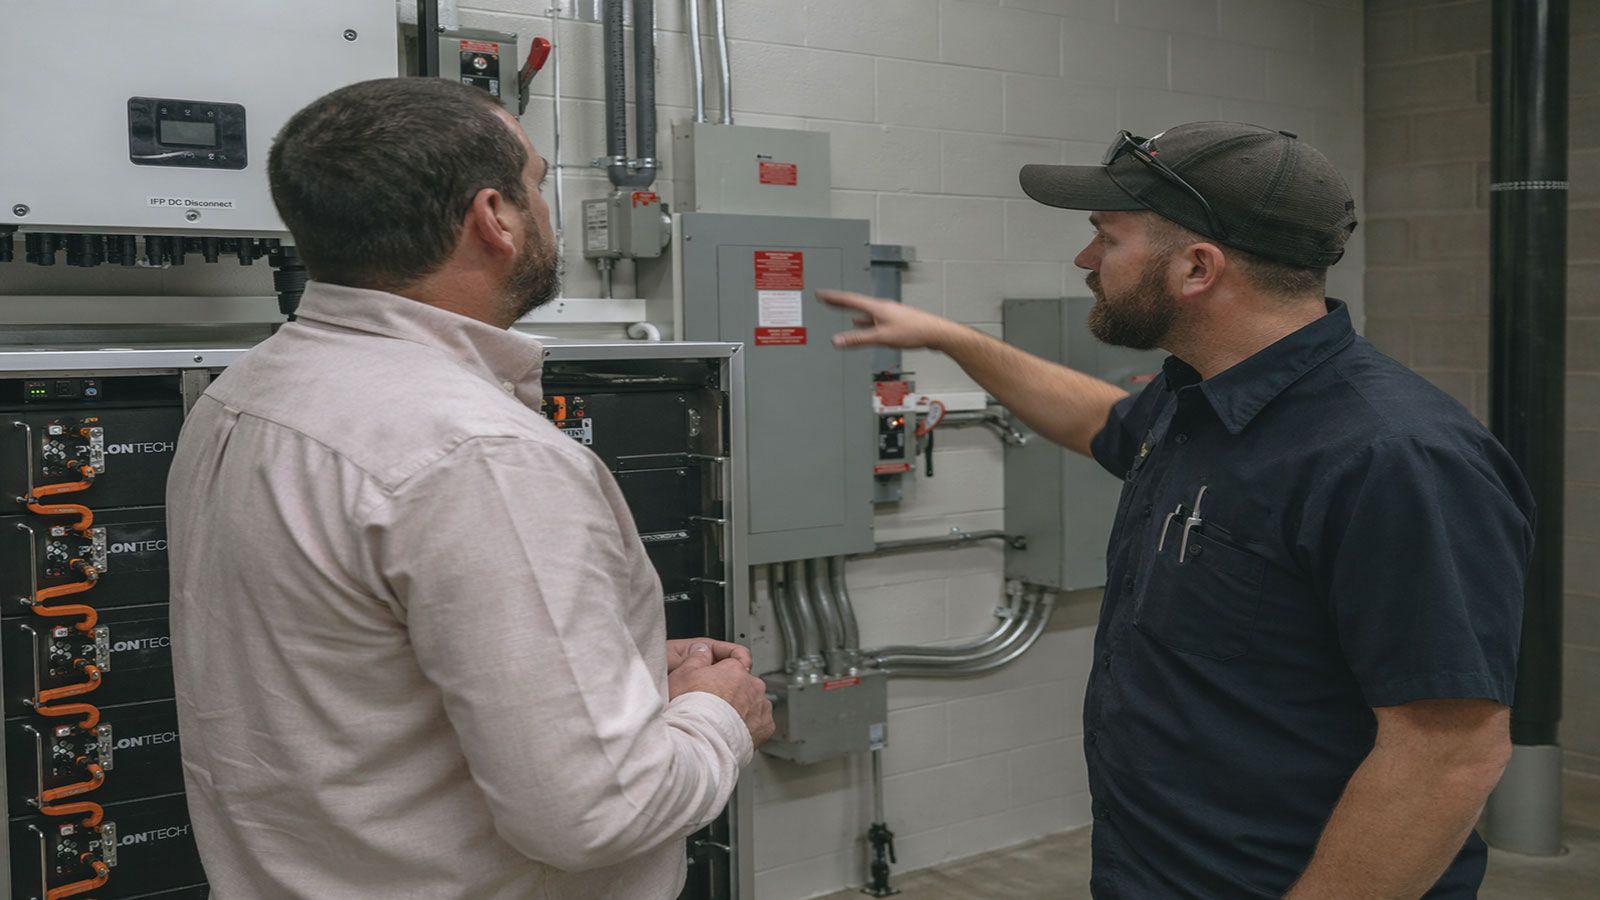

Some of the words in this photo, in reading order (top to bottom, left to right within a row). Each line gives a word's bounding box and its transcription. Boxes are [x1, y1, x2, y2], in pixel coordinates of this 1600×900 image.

[168, 198, 183, 206] DC
[184, 199, 233, 208] Disconnect
[76, 441, 174, 457] PONTECH
[88, 825, 187, 852] PONTECH
